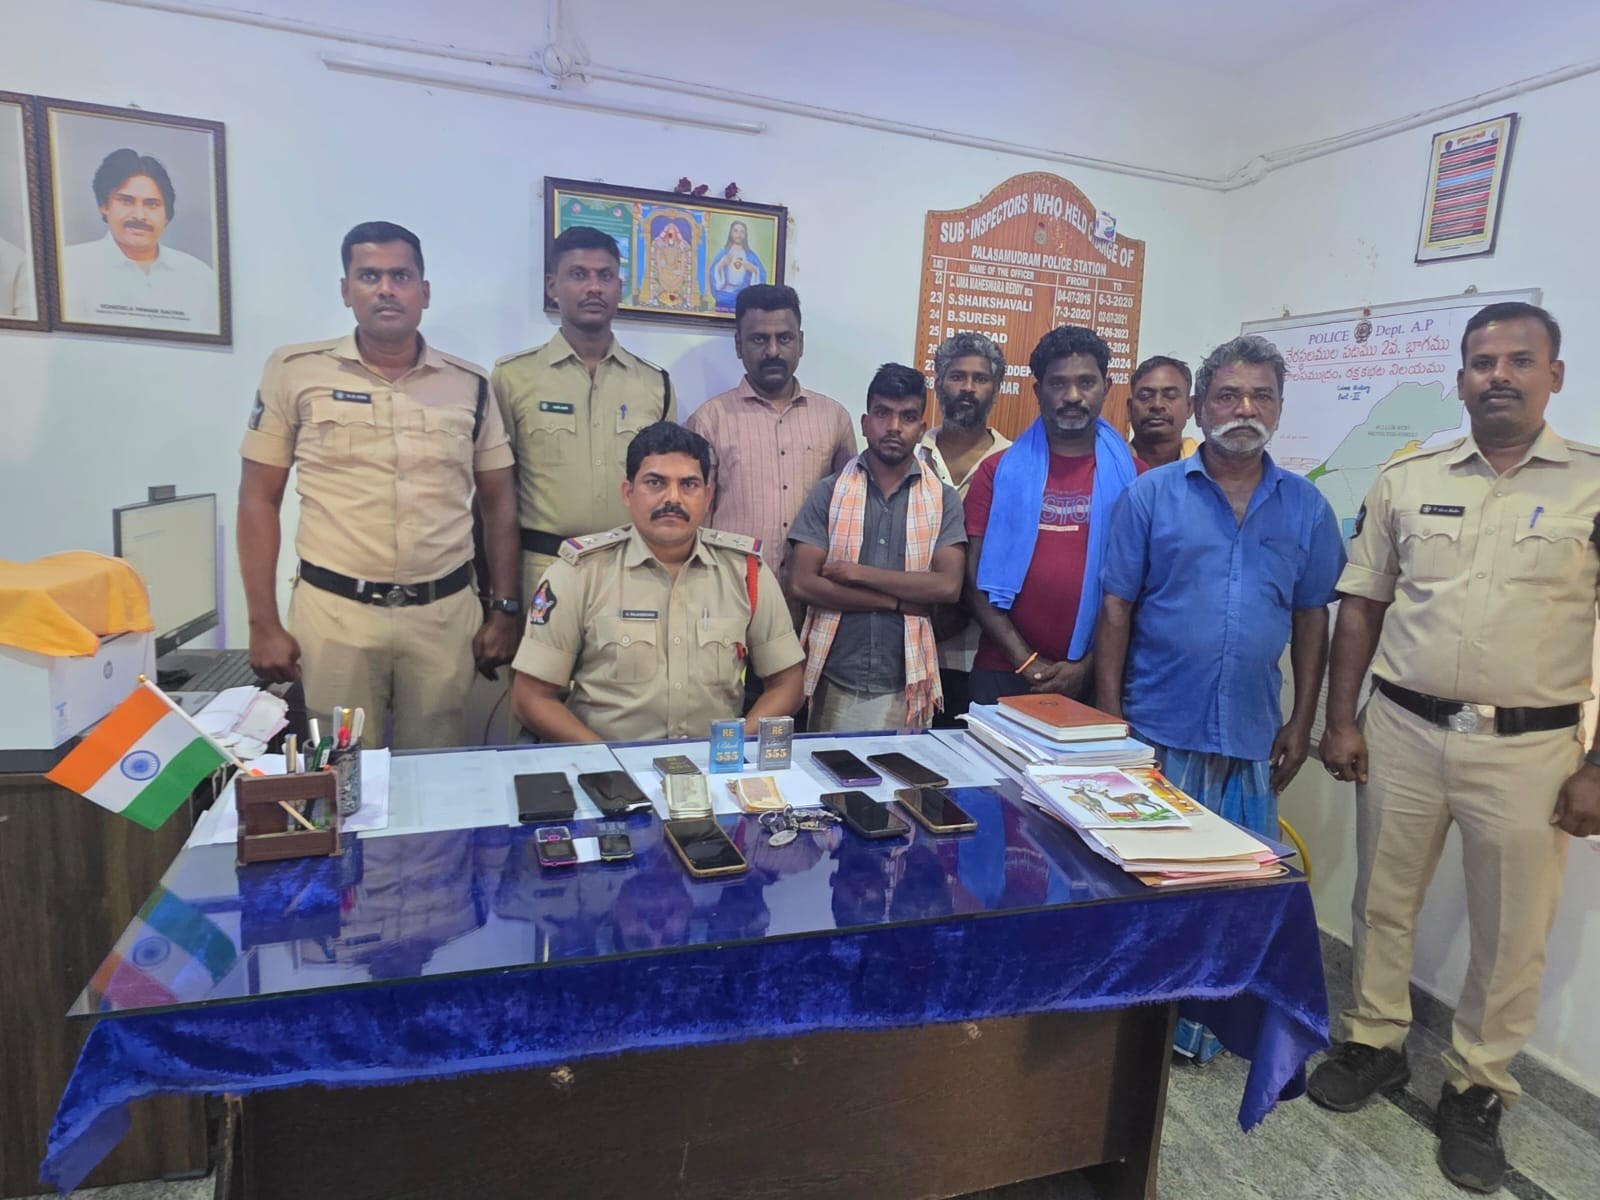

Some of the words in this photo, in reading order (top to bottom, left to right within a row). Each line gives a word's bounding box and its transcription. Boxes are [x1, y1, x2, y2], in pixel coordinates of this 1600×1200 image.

[1033, 192, 1063, 218] WHO
[1064, 201, 1087, 235] HELD
[1119, 247, 1134, 268] OF
[971, 245, 1040, 267] PALASAMUDRAM
[1042, 254, 1072, 271] POLICE
[1073, 258, 1107, 276] STATION
[969, 264, 986, 275] NAME
[987, 266, 996, 276] OF
[997, 267, 1008, 277] THE
[1010, 269, 1034, 281] OFFICER
[1066, 276, 1089, 288] FROM
[1112, 282, 1122, 291] TO
[929, 291, 942, 304] 23
[948, 293, 1032, 312] S.SHAIKSHAVALI
[929, 310, 940, 320] 24
[947, 310, 1006, 327] B.SURESH
[1055, 306, 1091, 320] 7-3-2020
[929, 325, 940, 336] 25
[1308, 330, 1350, 345] POLICE
[722, 728, 734, 737] RE
[771, 726, 783, 735] RE
[716, 751, 739, 762] 555
[764, 748, 787, 760] 555
